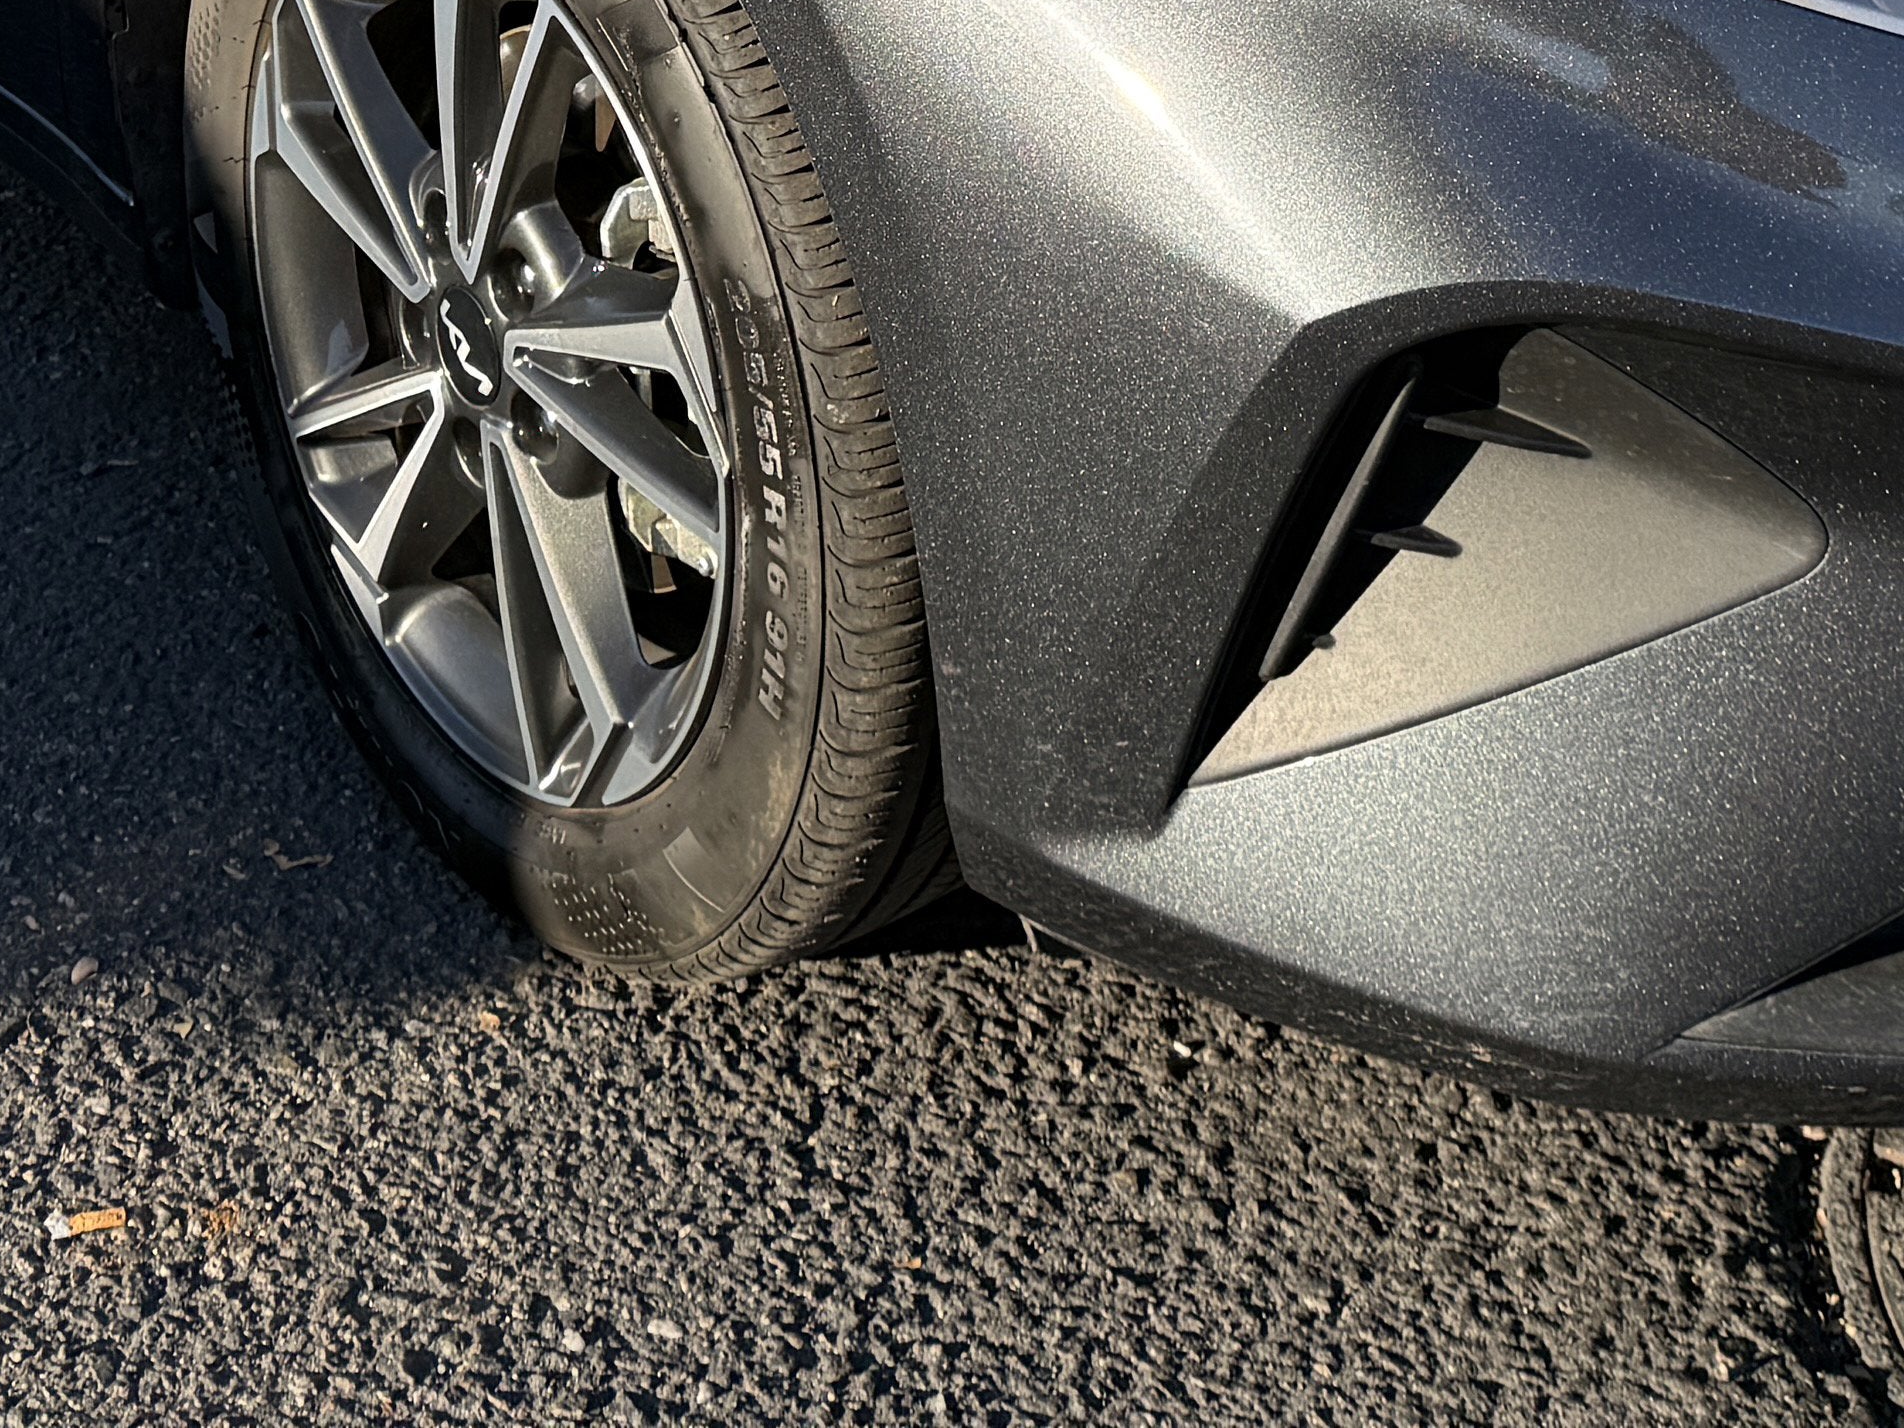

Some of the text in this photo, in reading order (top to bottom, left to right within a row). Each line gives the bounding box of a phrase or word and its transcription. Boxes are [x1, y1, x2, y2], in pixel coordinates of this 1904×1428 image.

[723, 278, 784, 481] 205/55
[763, 484, 790, 602] R16
[757, 609, 790, 721] 91H
